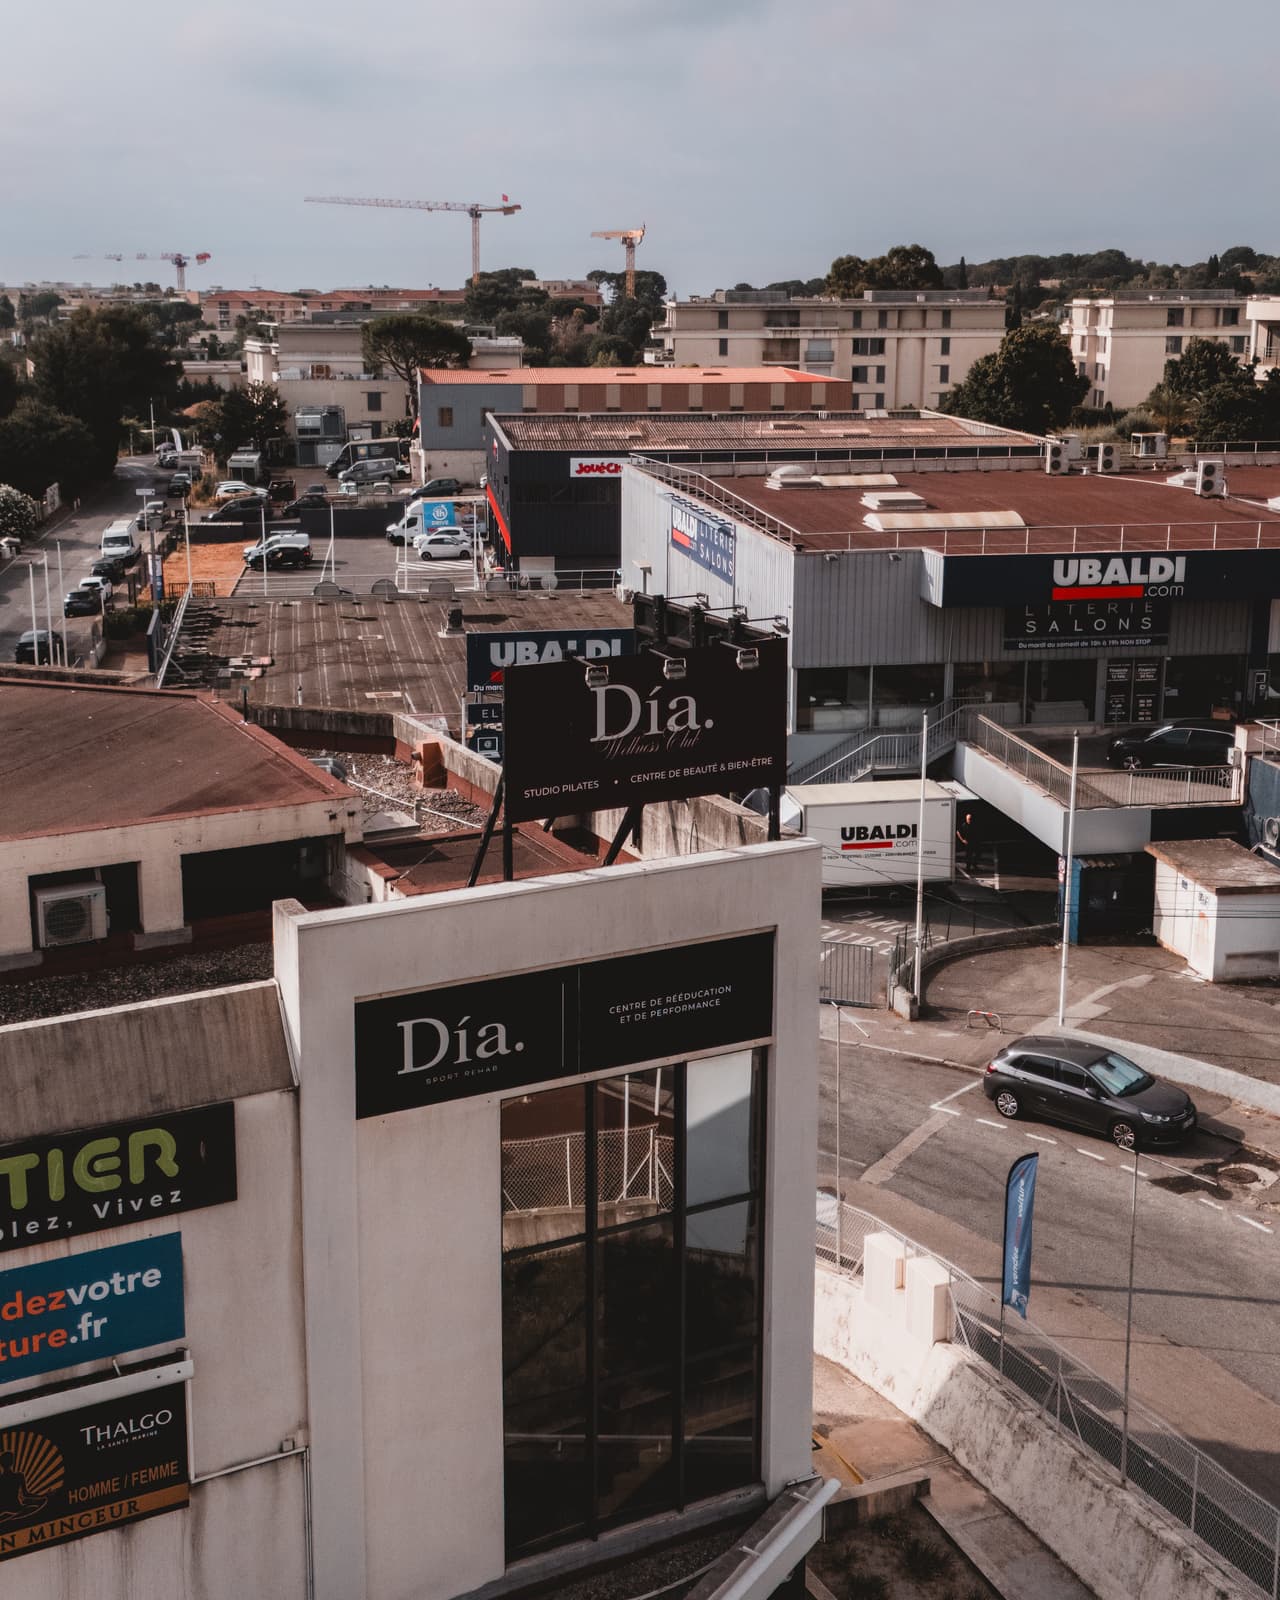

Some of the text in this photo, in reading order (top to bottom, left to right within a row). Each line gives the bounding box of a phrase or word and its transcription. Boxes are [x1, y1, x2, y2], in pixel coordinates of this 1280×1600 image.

[672, 506, 698, 540] UBALDI
[700, 521, 733, 554] LITERIE
[699, 543, 734, 576] SALONS
[1052, 556, 1187, 587] UBALDI
[1143, 585, 1184, 597] .com
[1025, 601, 1153, 617] LITERIE
[1025, 617, 1152, 633] SALONS
[1028, 641, 1046, 649] mardi
[1056, 640, 1080, 648] samedi
[473, 684, 485, 692] Du
[589, 683, 714, 742] Día.
[600, 725, 702, 760] Wellness Club
[523, 755, 773, 799] STUDIO PILATES CENTRE DE BEAUTÉ & BIEN-ÊTRE
[840, 823, 918, 841] UBALDI
[893, 840, 918, 849] .com
[608, 984, 732, 1014] CENTRE DE RÉÉDUCATION
[619, 998, 721, 1024] ET DE PERFORMANCE
[396, 1015, 525, 1076] Día.
[425, 1065, 499, 1085] SPORT REHAB
[0, 1127, 180, 1211] TIER
[0, 1189, 182, 1240] lez, Vivez
[79, 1409, 173, 1446] THALGO
[68, 1476, 121, 1505] HOMME
[131, 1460, 179, 1487] FEMME
[27, 1499, 141, 1544] MINCEUR
